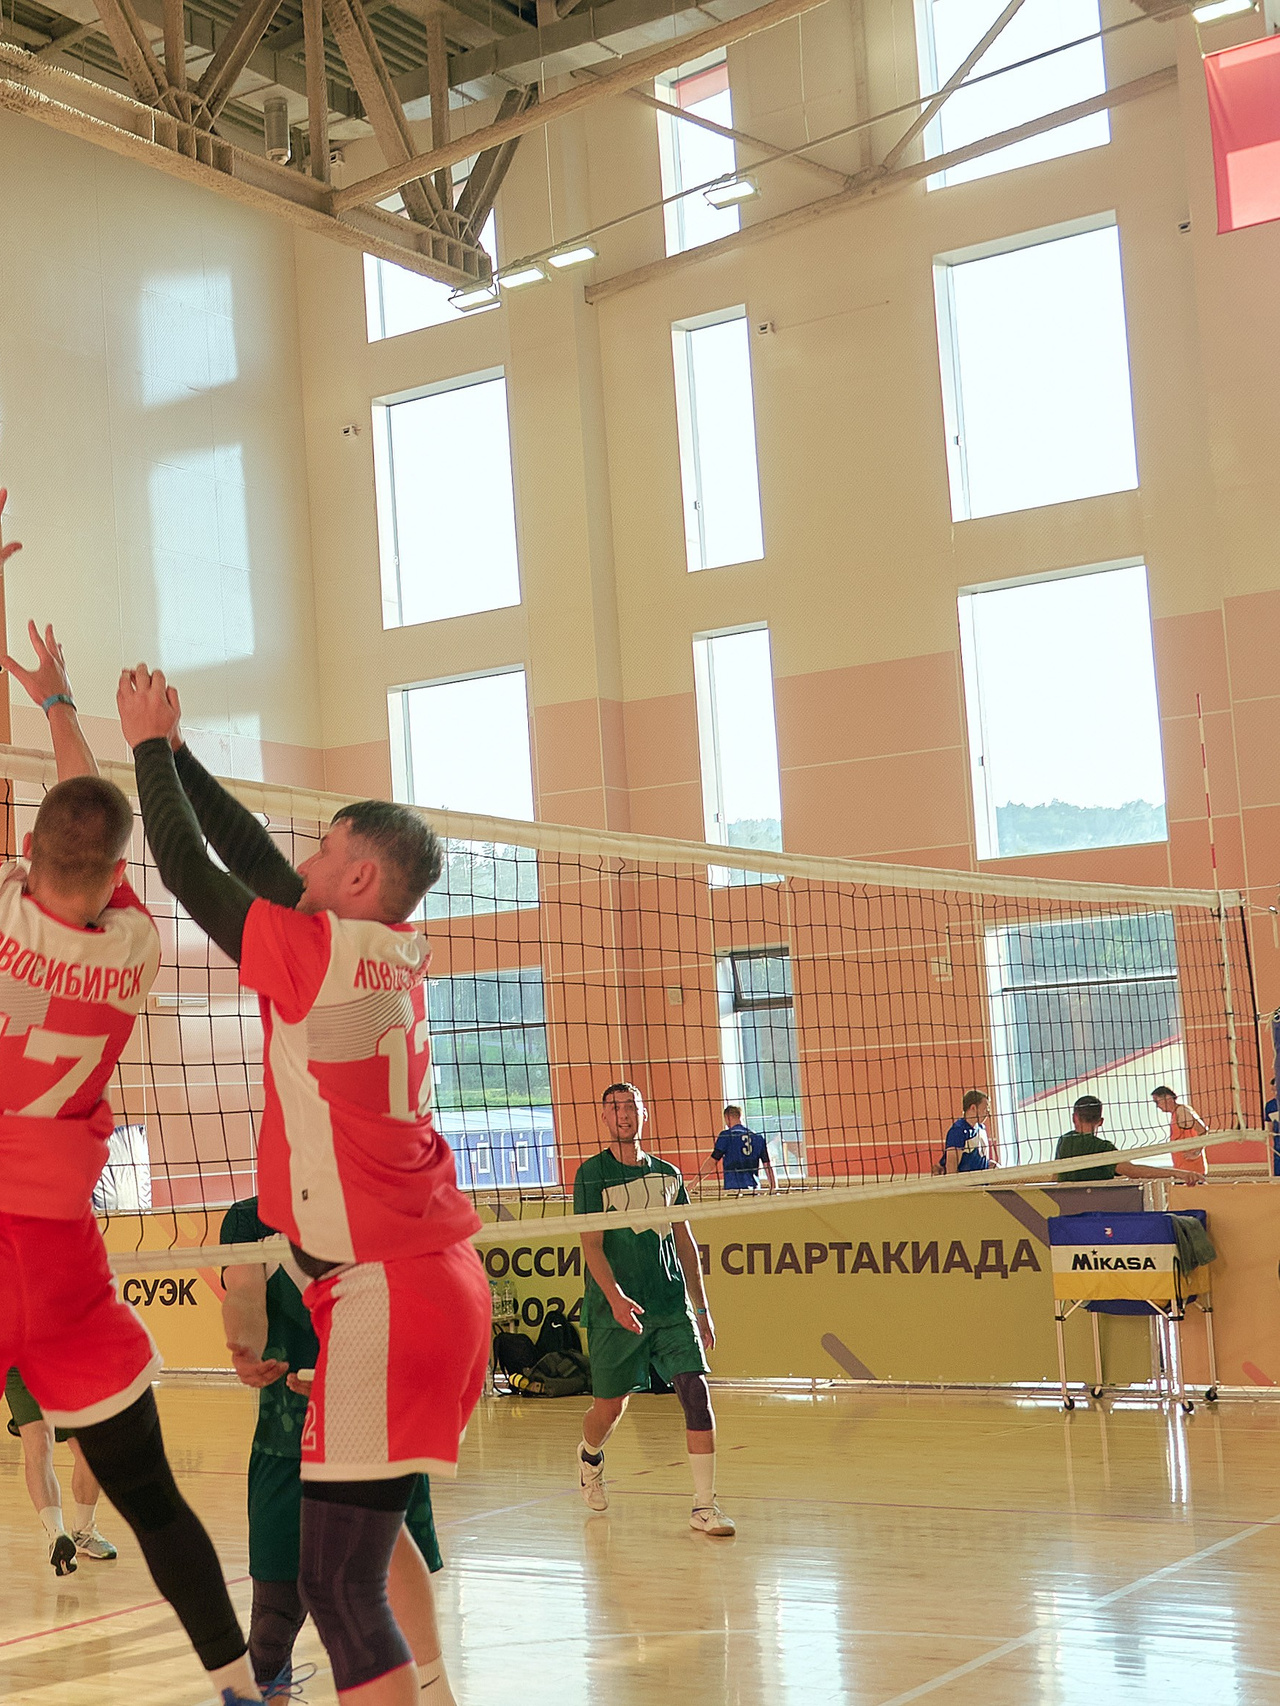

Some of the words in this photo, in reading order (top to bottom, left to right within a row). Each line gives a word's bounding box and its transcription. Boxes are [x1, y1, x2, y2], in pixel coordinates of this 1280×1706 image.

[741, 1134, 753, 1156] 3
[721, 1238, 1042, 1280] СПАРТАКИАДА
[123, 1278, 197, 1306] СУЭК
